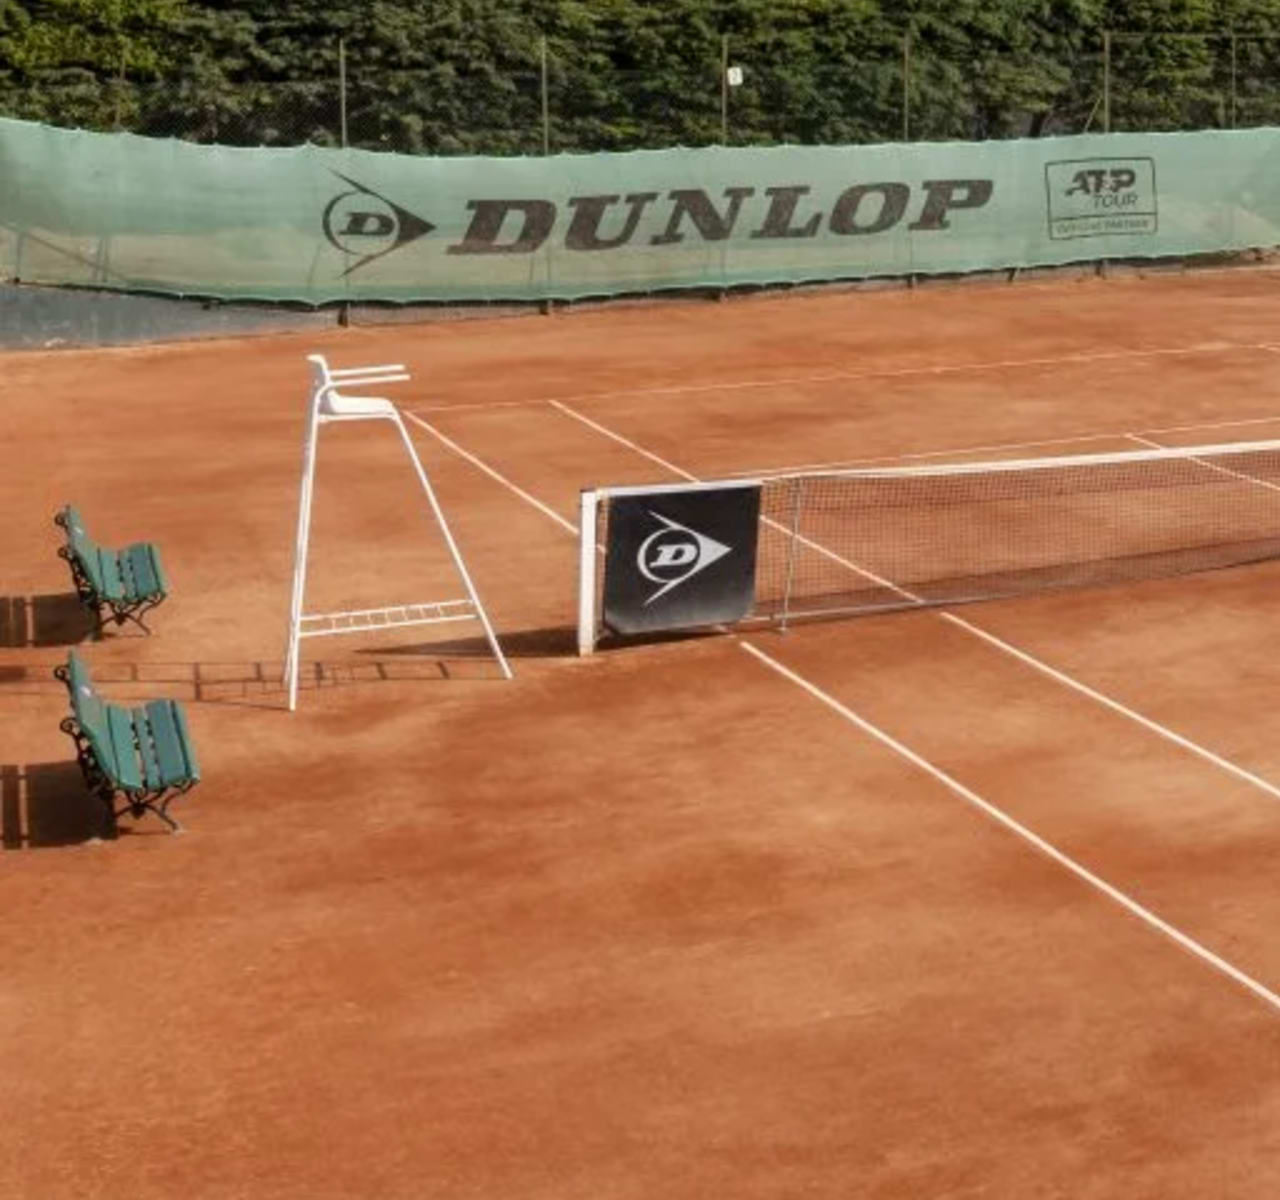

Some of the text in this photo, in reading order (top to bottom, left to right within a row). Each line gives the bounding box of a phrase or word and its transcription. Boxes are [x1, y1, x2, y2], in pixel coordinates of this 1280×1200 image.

[1065, 169, 1136, 196] ATP
[1094, 193, 1138, 208] TOUR
[338, 180, 993, 255] D DUNLOP
[649, 544, 697, 568] D
